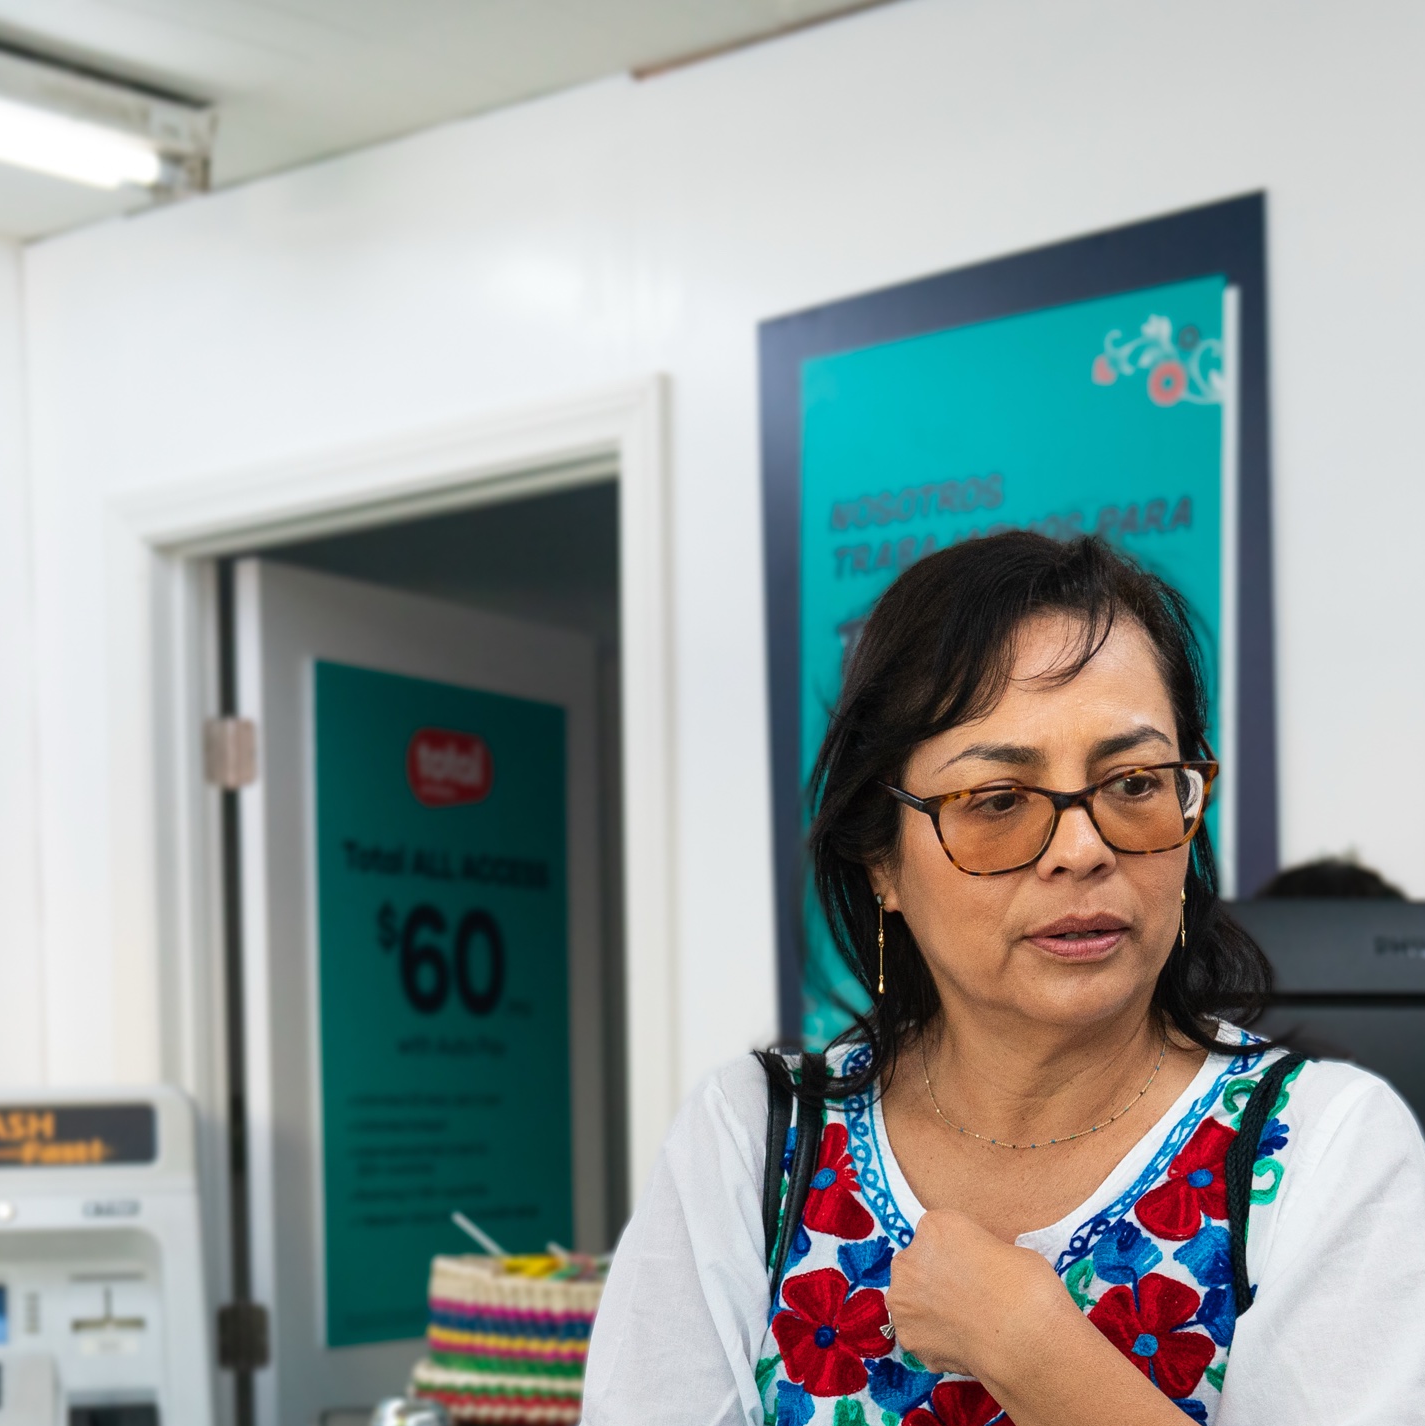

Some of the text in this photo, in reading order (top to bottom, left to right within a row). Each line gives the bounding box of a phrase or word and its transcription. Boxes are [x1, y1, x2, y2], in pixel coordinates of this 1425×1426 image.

[829, 471, 1005, 533] NOSOTROS
[1095, 494, 1194, 539] PARA
[376, 898, 506, 1017] $60
